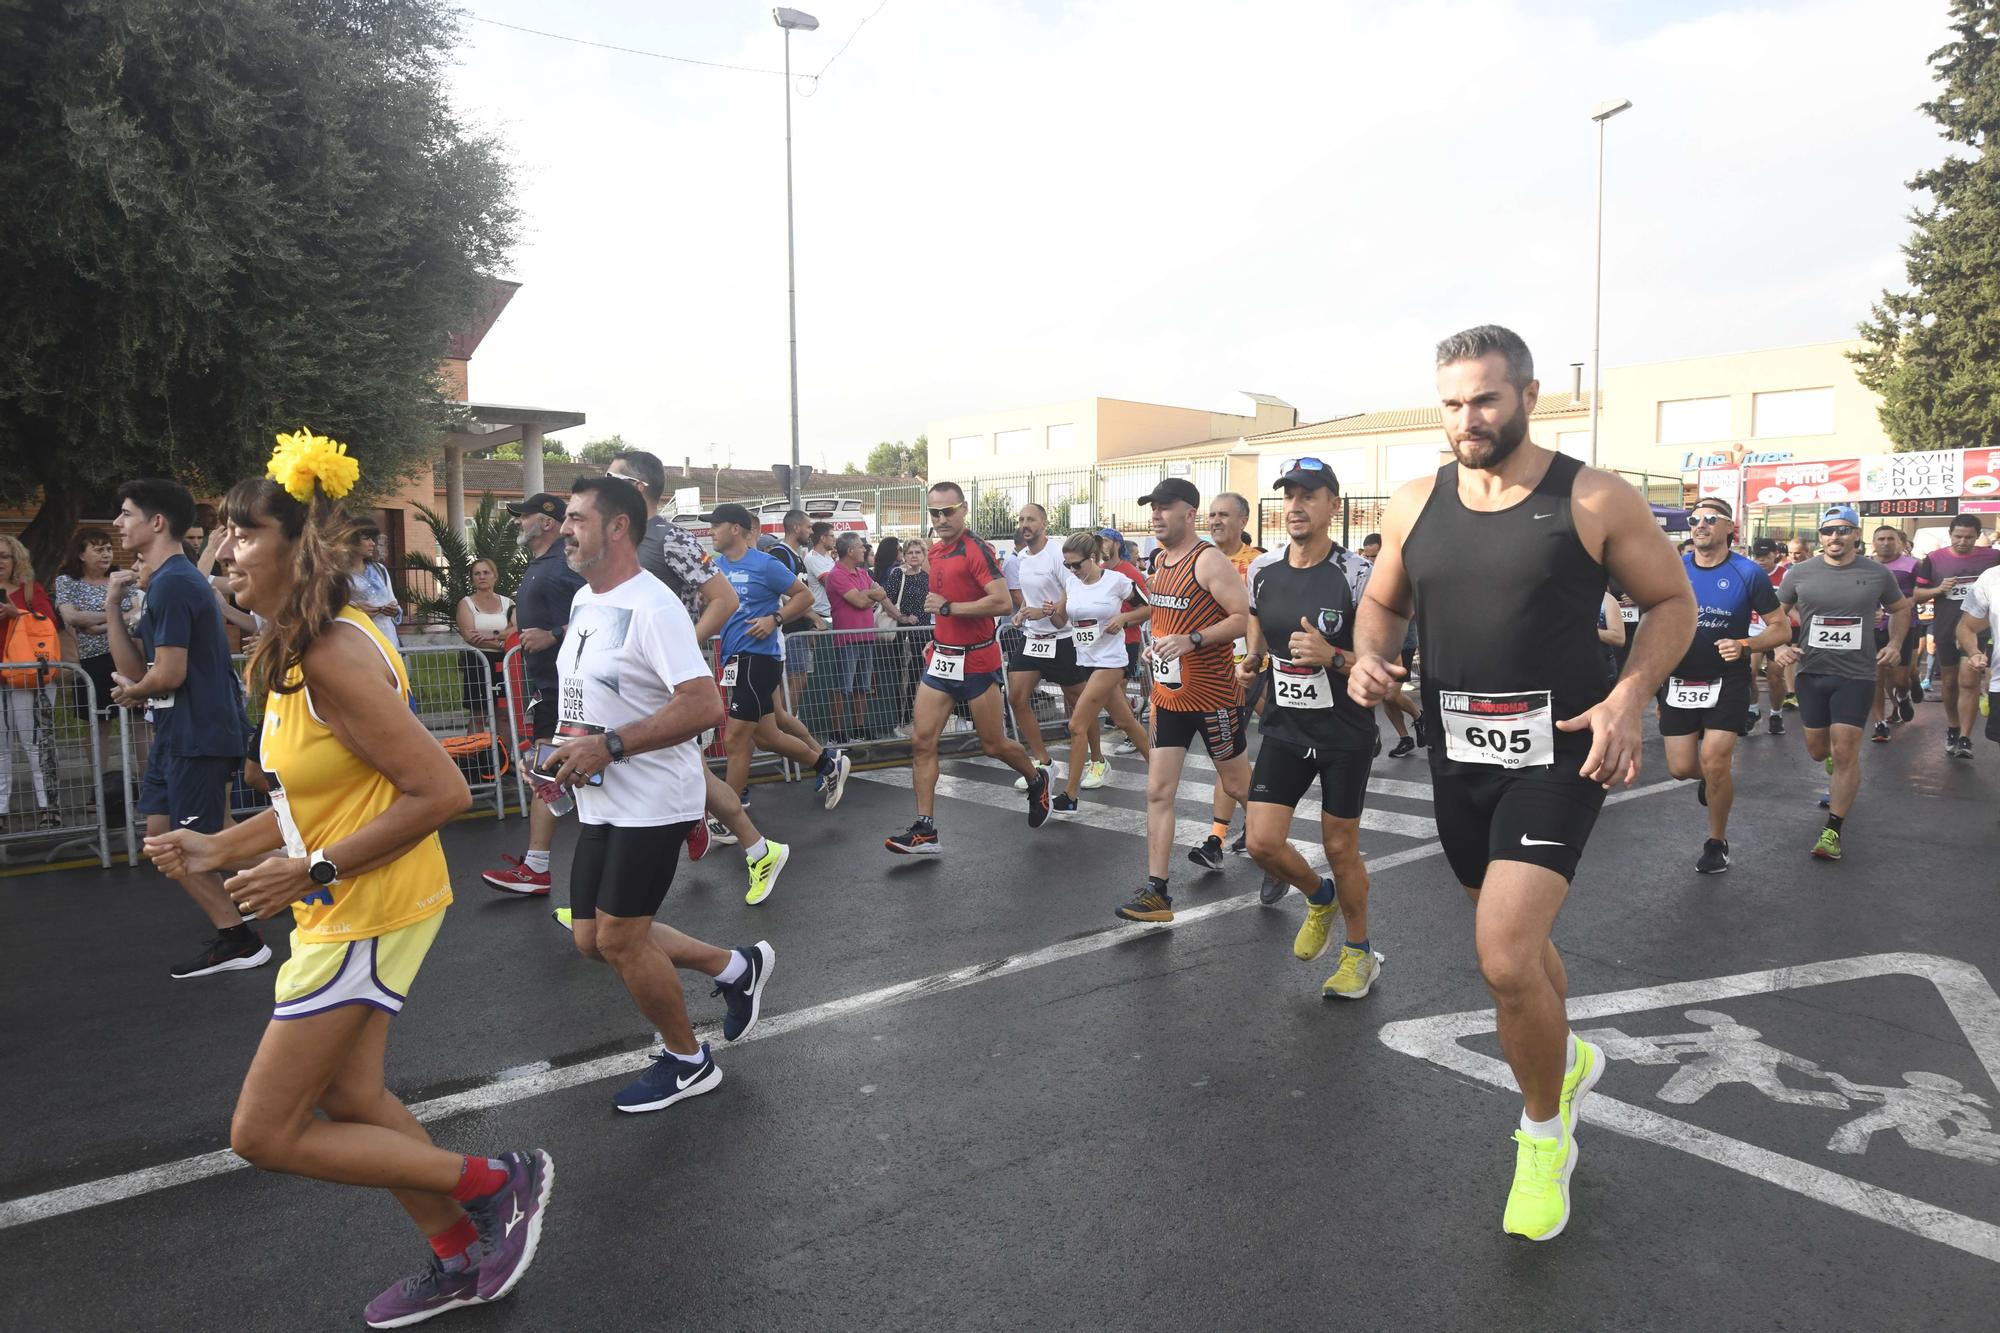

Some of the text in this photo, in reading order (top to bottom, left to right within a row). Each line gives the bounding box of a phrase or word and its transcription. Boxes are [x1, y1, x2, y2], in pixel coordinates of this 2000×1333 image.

[1892, 453, 1955, 466] XXVIII
[1892, 464, 1955, 476] NON
[1892, 474, 1955, 487] DUER
[1892, 485, 1955, 497] MAS
[1076, 632, 1095, 642] 035
[1819, 631, 1852, 643] 244
[1031, 643, 1050, 653] 207
[935, 659, 956, 673] 337
[563, 686, 584, 699] NON
[1278, 681, 1318, 700] 254
[1677, 691, 1710, 703] 536
[563, 698, 584, 711] DUER
[563, 709, 585, 721] MAS
[1465, 726, 1532, 754] 605
